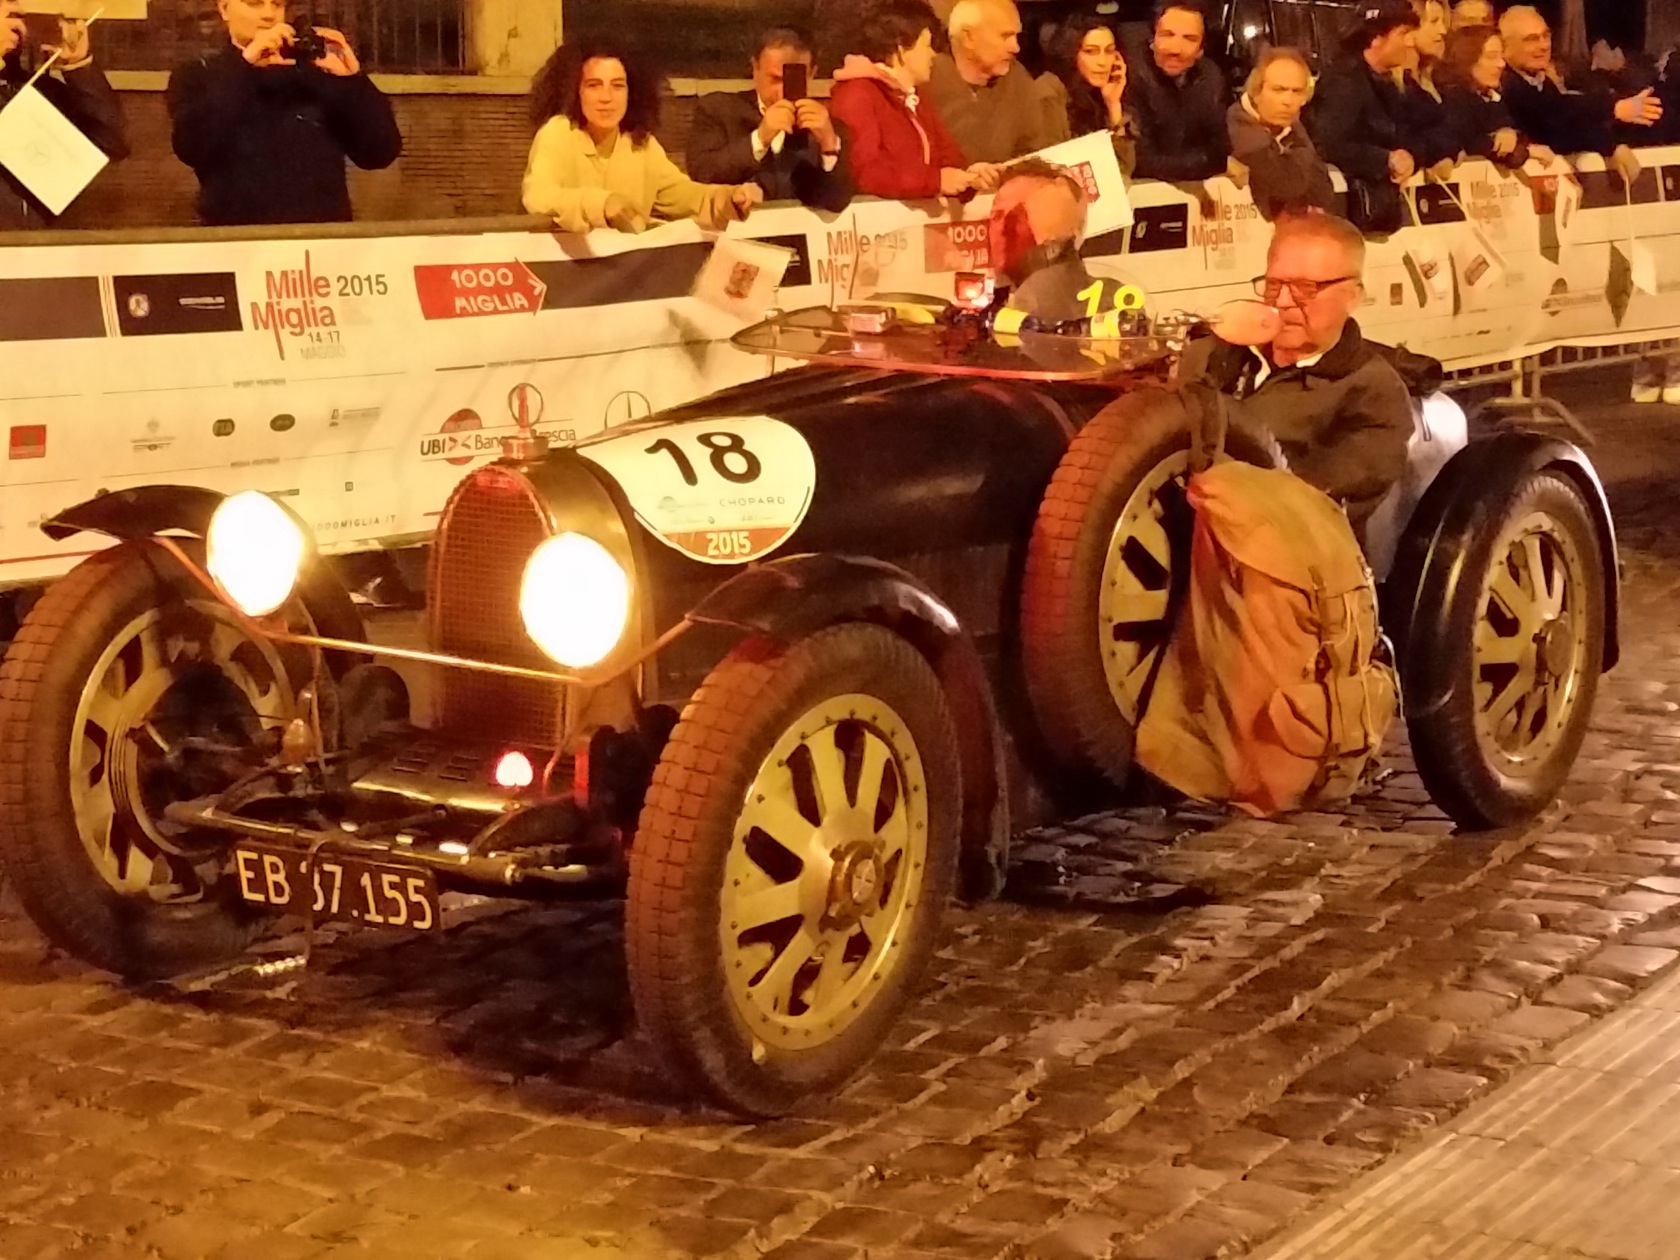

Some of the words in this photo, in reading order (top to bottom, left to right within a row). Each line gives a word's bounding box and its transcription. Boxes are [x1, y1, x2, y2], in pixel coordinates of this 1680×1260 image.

[1234, 203, 1257, 220] 2015
[826, 213, 871, 256] Mille
[1192, 223, 1233, 269] Miglia
[266, 249, 331, 299] Mille
[336, 274, 388, 297] 2015
[451, 268, 514, 289] 1000
[454, 291, 530, 315] MIGLIA
[1077, 279, 1147, 317] 18
[250, 299, 336, 361] Miglia
[420, 438, 446, 456] UBI
[644, 431, 762, 487] 18
[719, 496, 786, 508] CHOPARD
[707, 532, 752, 556] 2015
[236, 849, 291, 905] EB
